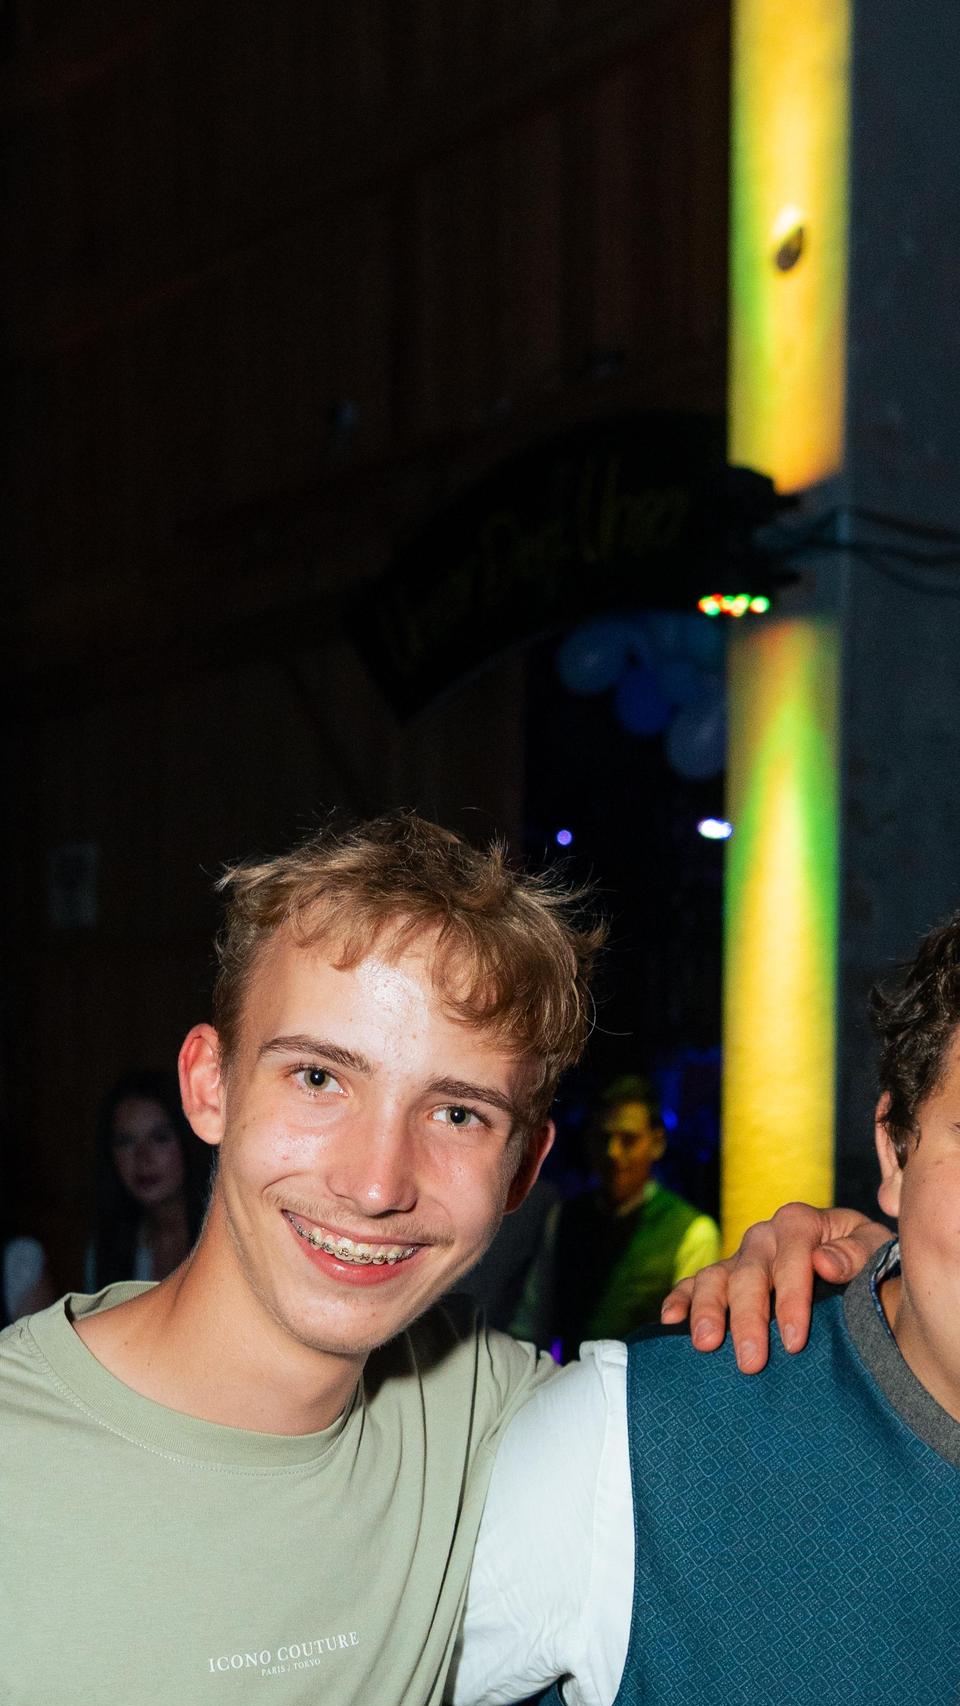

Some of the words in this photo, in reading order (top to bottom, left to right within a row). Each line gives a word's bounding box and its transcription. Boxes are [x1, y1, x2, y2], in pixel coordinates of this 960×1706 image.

[207, 1649, 272, 1673] ICONO
[277, 1631, 360, 1662] COUTURE
[261, 1664, 286, 1677] PARIS
[293, 1658, 321, 1670] TOKYO
